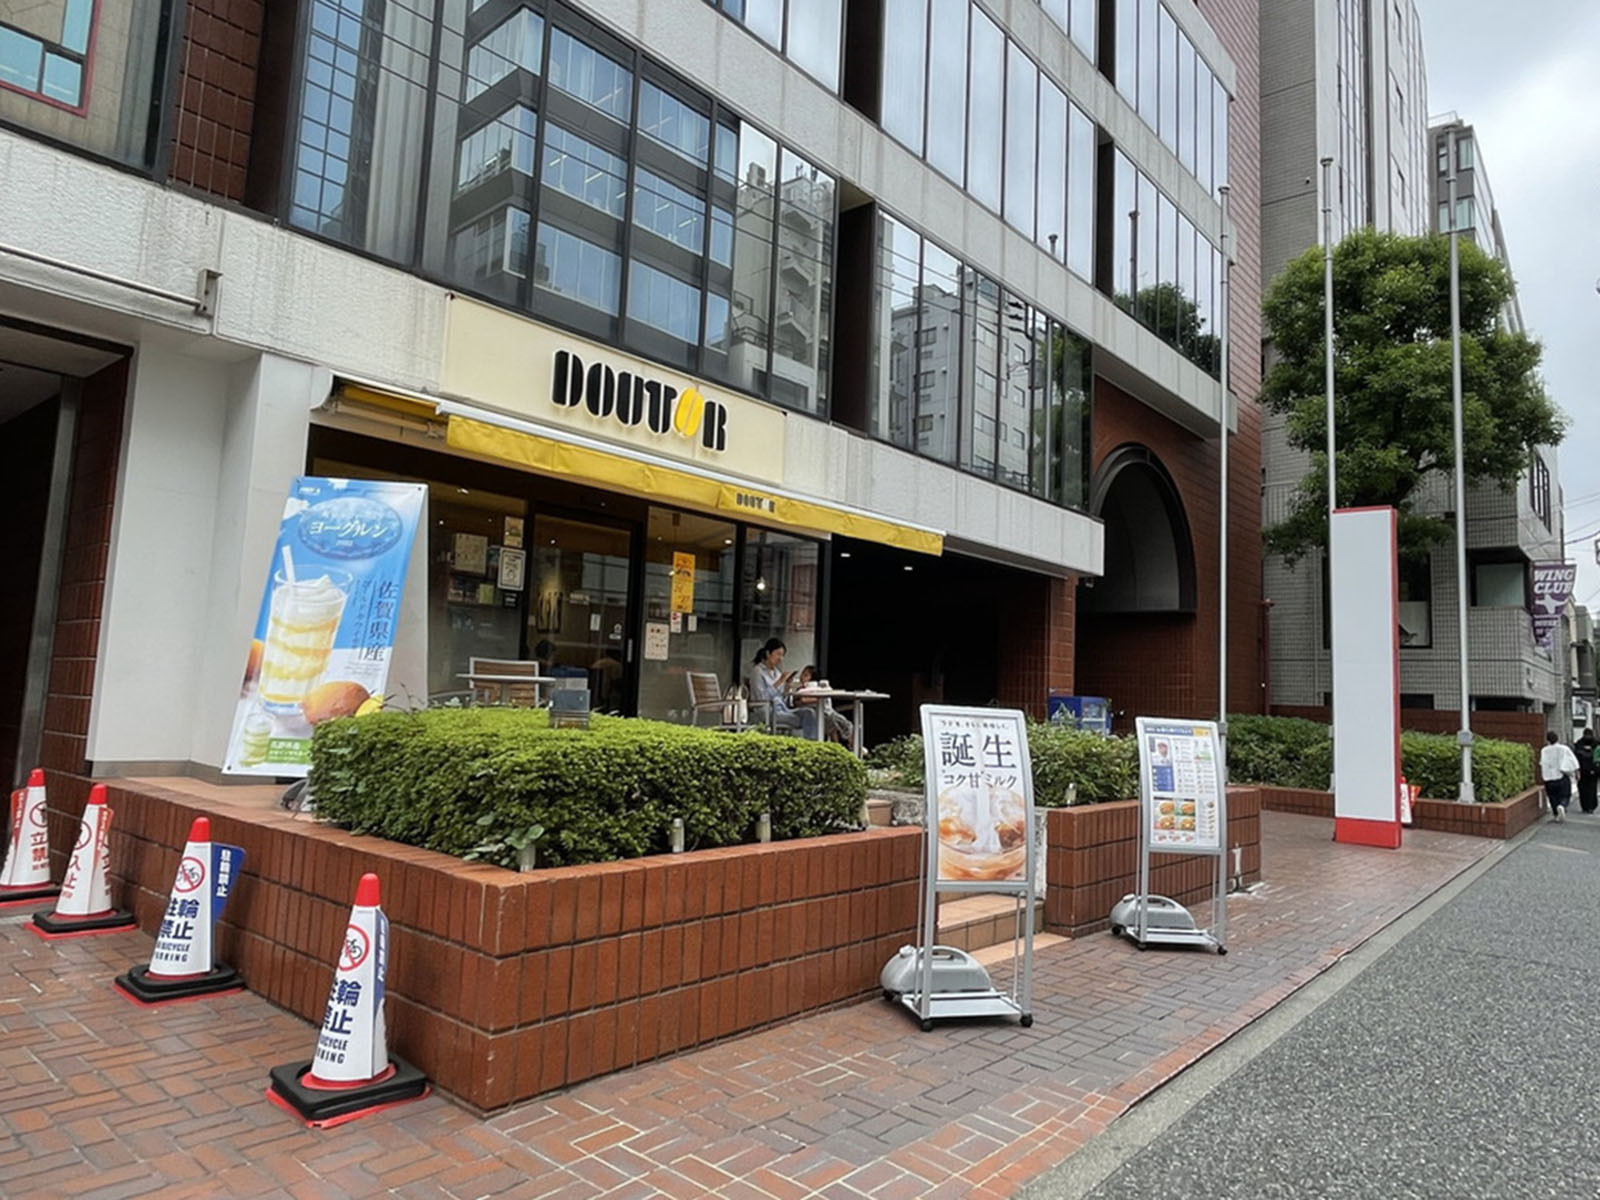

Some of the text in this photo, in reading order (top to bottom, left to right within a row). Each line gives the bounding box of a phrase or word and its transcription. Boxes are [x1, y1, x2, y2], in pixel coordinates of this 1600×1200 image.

[552, 351, 727, 451] DOUTOR
[1534, 569, 1573, 580] WING
[1534, 582, 1572, 593] CLUB
[364, 580, 400, 662] 佐賀県産
[940, 731, 1017, 769] 誕生
[329, 978, 362, 1007] 輪
